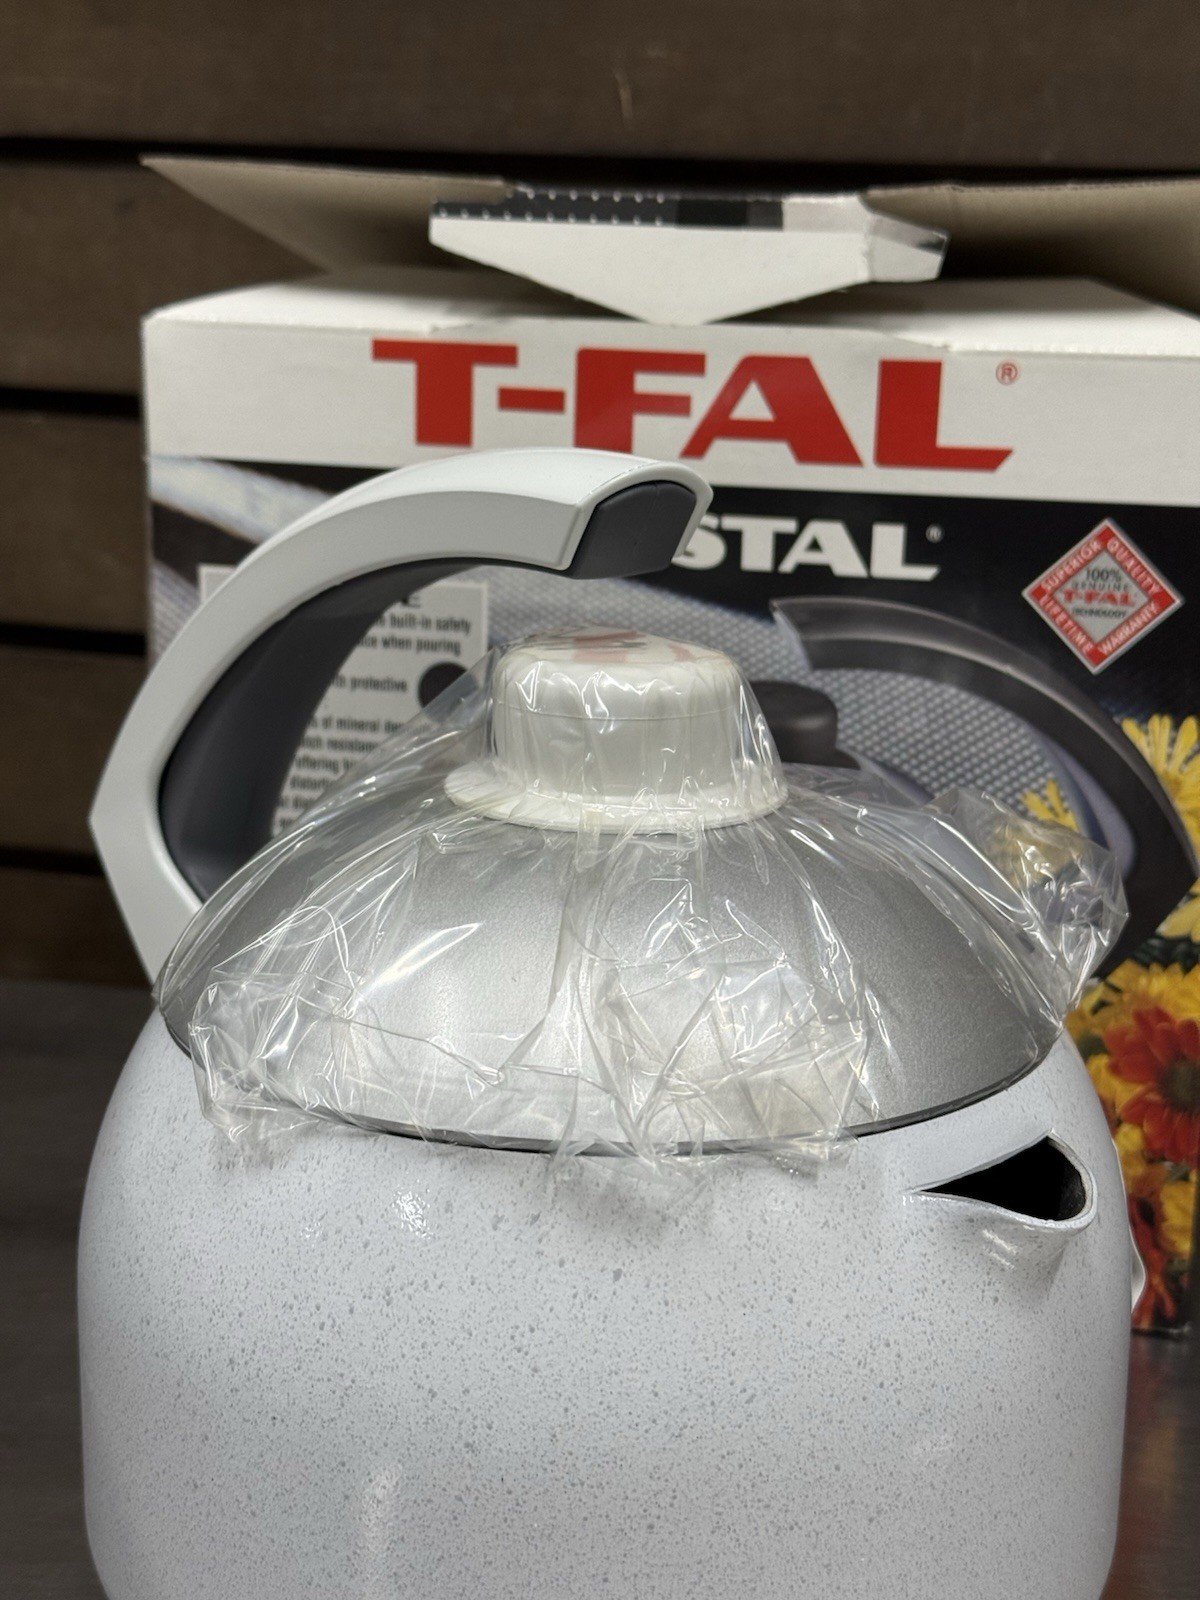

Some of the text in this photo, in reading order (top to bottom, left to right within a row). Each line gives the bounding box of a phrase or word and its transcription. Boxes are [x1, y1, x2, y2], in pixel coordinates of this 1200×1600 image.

[372, 339, 1014, 472] T-FAL
[1040, 540, 1101, 591] SUPERIOR
[1086, 567, 1122, 582] 100%
[1106, 537, 1161, 594] QUALITY
[390, 612, 432, 630] built-in
[436, 616, 471, 636] safety
[1039, 592, 1095, 654] LIFETIME
[1098, 601, 1159, 655] WARRANTY
[382, 635, 412, 651] when
[416, 638, 461, 657] pouring
[350, 677, 408, 692] protective
[336, 717, 380, 732] mineral
